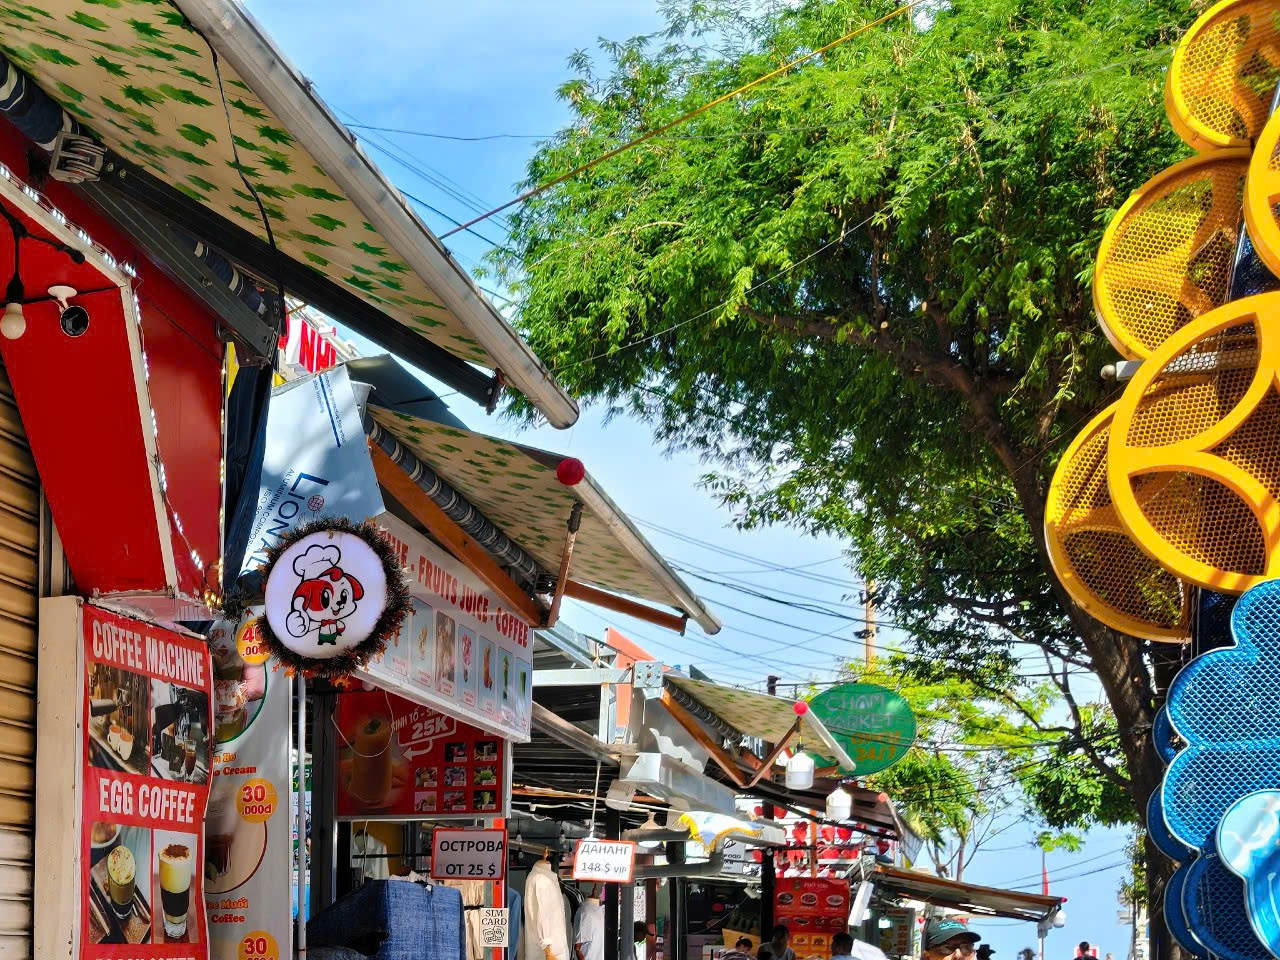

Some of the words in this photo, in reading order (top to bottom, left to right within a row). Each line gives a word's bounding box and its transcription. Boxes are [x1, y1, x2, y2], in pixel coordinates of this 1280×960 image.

[261, 488, 273, 503] ISO
[267, 468, 295, 511] ALUMINIUM
[246, 511, 270, 550] COMPOS
[418, 555, 458, 605] FRUITS
[460, 584, 489, 624] JUICE
[495, 607, 529, 648] COFFEE
[93, 619, 143, 670] COFFEE
[145, 636, 205, 687] MACHINE
[411, 715, 448, 740] 25K
[855, 745, 896, 762] 24/7
[222, 766, 257, 776] Cream
[100, 777, 133, 816] EGG
[138, 783, 196, 824] COFFEE
[242, 784, 266, 803] 30
[440, 840, 504, 852] ОСТРОВА
[581, 843, 630, 855] ДАНАНГ
[445, 863, 464, 875] ОТ
[467, 863, 483, 876] 25
[488, 862, 496, 878] $
[581, 862, 600, 872] 148
[604, 862, 611, 875] $
[613, 866, 627, 874] VIP
[211, 914, 245, 923] Coffee
[485, 909, 503, 917] SIM
[481, 918, 507, 926] CARD
[243, 937, 268, 955] 30
